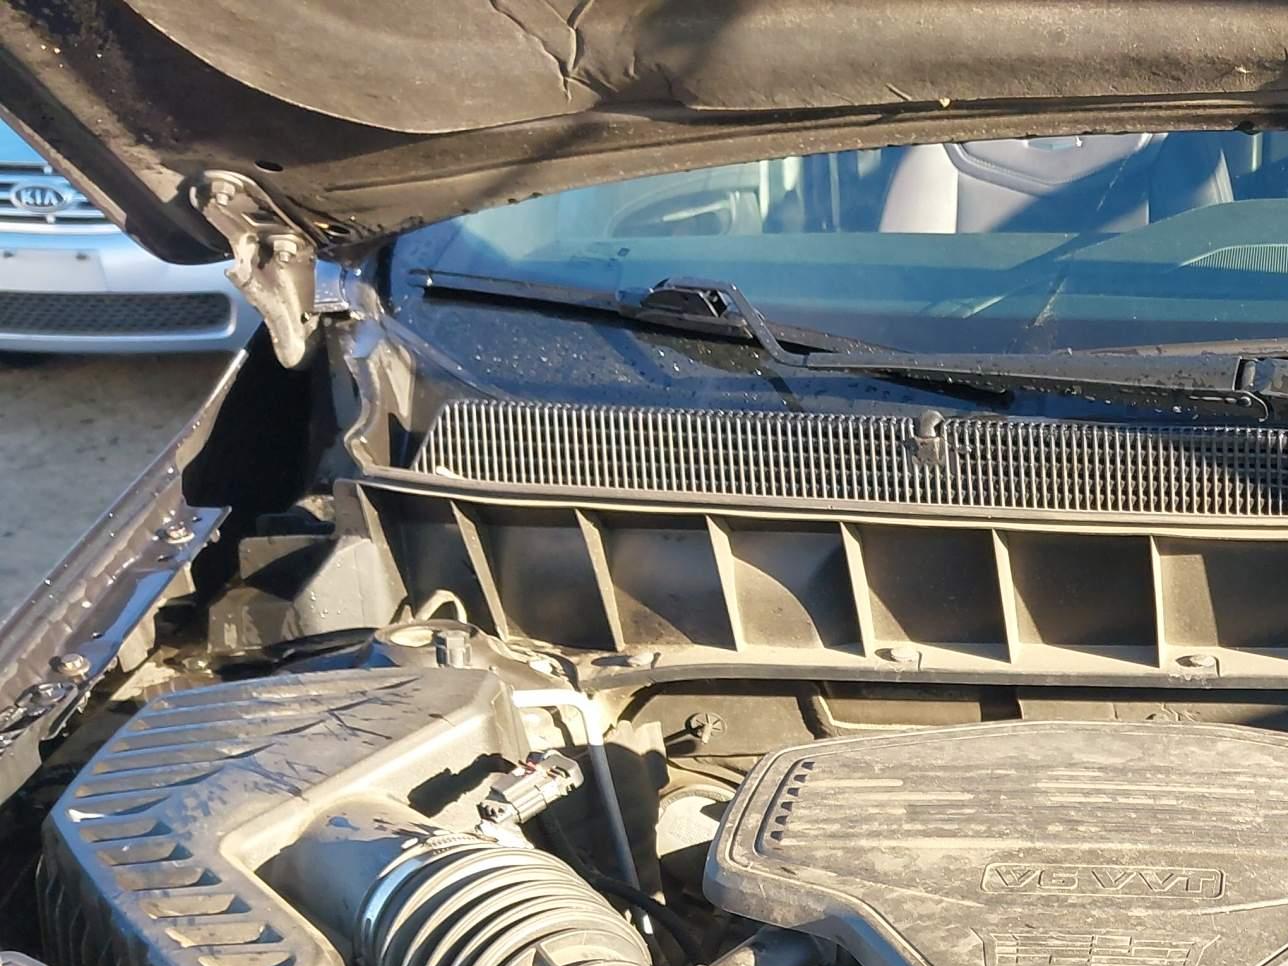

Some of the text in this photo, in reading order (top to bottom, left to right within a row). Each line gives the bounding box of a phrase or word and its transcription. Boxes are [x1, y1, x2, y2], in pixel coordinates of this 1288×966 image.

[21, 188, 58, 206] KIA
[994, 867, 1217, 894] V6 VVT
